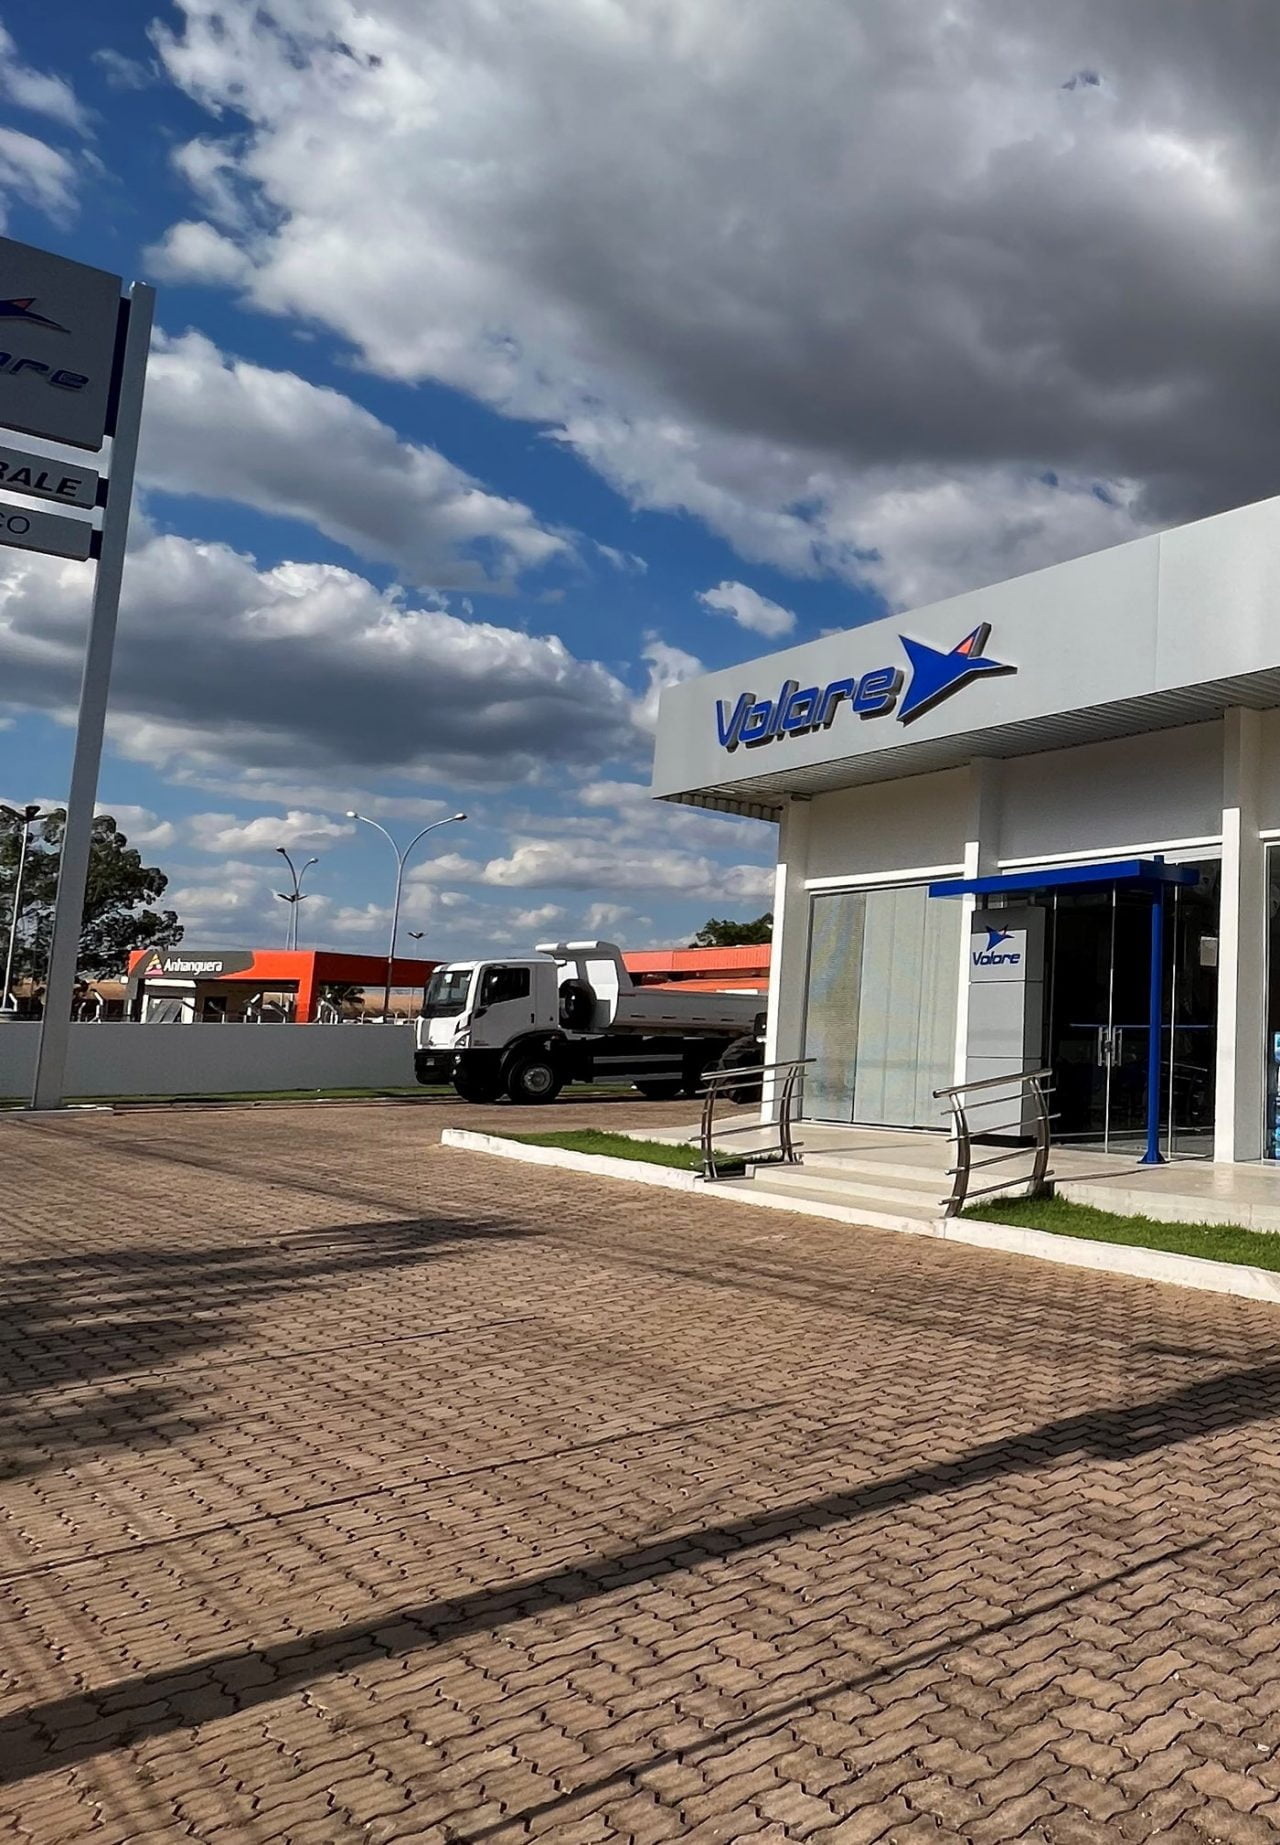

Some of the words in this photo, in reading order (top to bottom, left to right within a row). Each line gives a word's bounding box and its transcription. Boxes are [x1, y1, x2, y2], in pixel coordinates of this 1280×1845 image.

[0, 513, 30, 535] O
[716, 666, 904, 752] Volare
[163, 958, 223, 976] Anhanguera
[973, 951, 1020, 966] Volare
